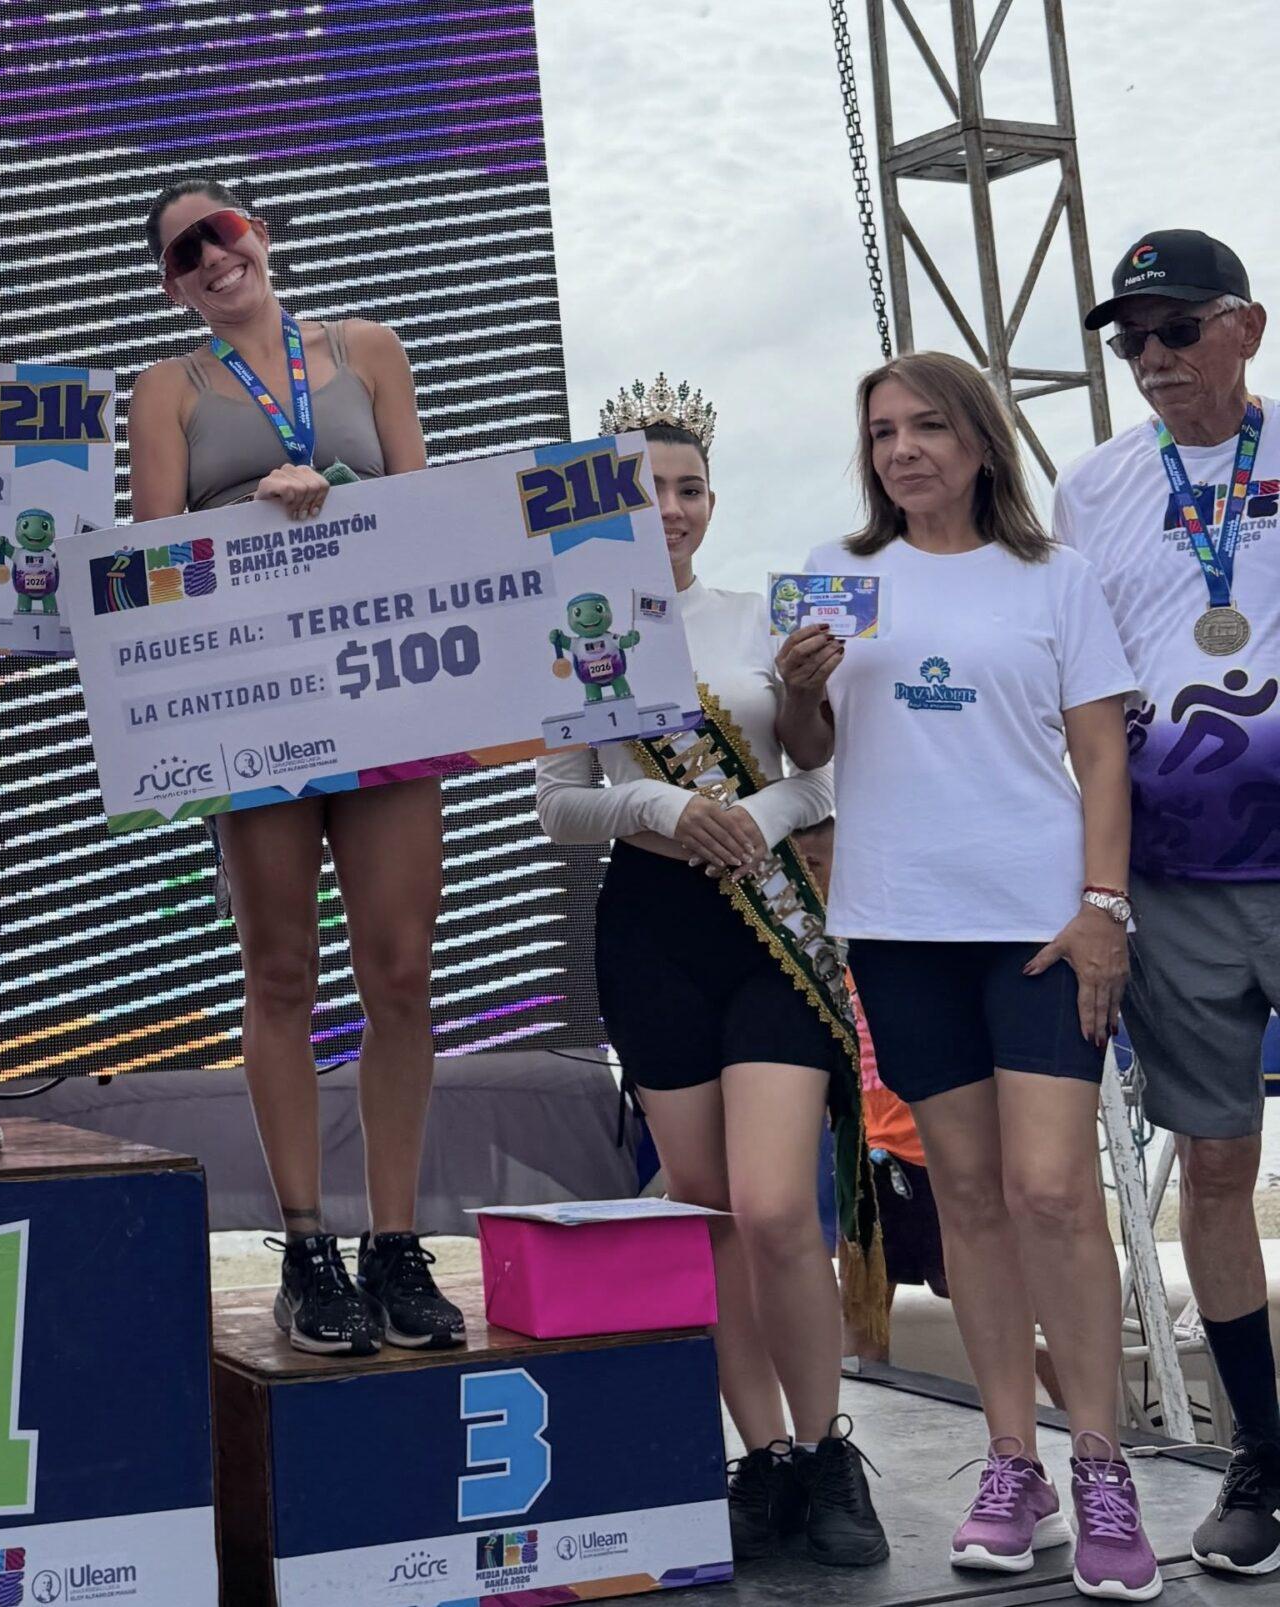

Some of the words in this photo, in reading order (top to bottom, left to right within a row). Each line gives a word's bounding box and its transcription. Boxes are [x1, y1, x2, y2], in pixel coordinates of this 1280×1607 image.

[1146, 270, 1166, 279] Pro
[226, 531, 285, 557] MEDIA
[288, 513, 378, 545] MARATÓN
[229, 549, 288, 575] BAHÍA
[291, 540, 340, 563] 2026
[25, 577, 45, 586] 2026
[244, 563, 311, 584] EDICIÓN
[810, 576, 845, 592] 21K
[119, 630, 219, 666] PÁGUESE
[228, 624, 265, 646] AL:
[287, 591, 415, 639] TERCER
[428, 569, 543, 613] LUGAR
[32, 625, 41, 640] 1
[336, 624, 481, 700] $100
[589, 663, 612, 674] 2026
[895, 683, 932, 699] PLAZA
[130, 703, 158, 726] LA
[167, 681, 280, 719] CANTIDAD
[290, 674, 326, 696] DE:
[607, 711, 618, 727] 1
[655, 713, 666, 726] 3
[560, 725, 572, 740] 2
[268, 738, 336, 763] Uleam
[458, 1367, 552, 1522] 3
[582, 1531, 628, 1550] Uleam
[69, 1564, 137, 1588] Uleam
[475, 1569, 500, 1581] MEDIA
[501, 1564, 539, 1579] MARATÓN
[510, 1574, 531, 1584] 2026
